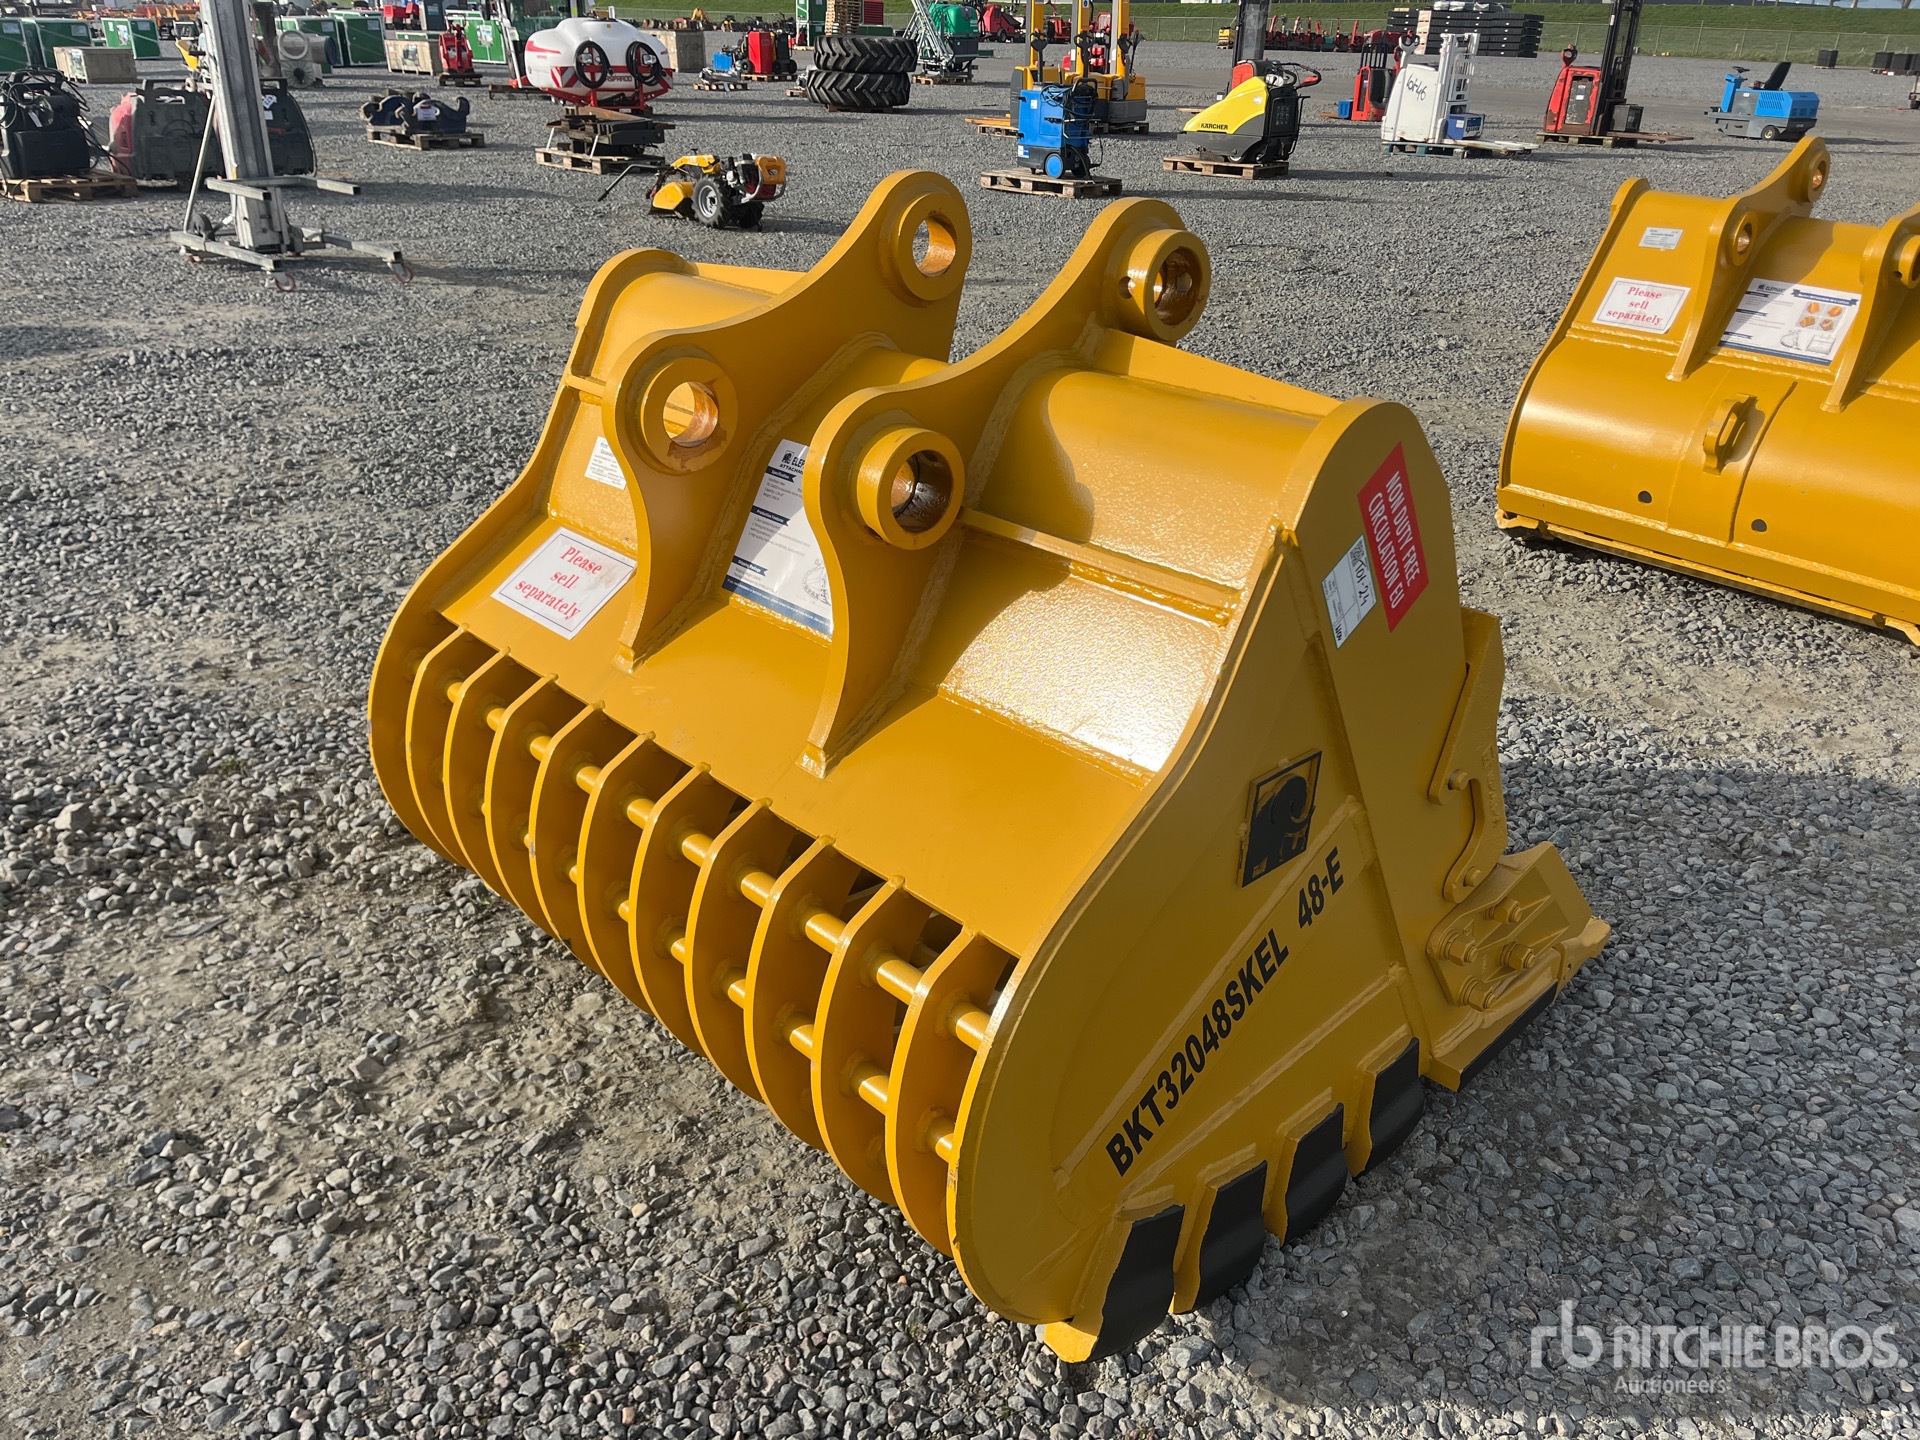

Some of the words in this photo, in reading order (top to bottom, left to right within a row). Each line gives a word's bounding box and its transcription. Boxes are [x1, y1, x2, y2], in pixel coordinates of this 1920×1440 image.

[1627, 286, 1662, 300] Please
[1628, 300, 1649, 310] sell
[1606, 309, 1663, 326] separately
[1386, 470, 1404, 513] NON
[1368, 492, 1400, 589] CIRCULATION
[1389, 582, 1405, 609] EU
[1393, 508, 1413, 551] DUTY
[552, 568, 579, 590] sell
[560, 547, 603, 575] Please
[1402, 545, 1421, 587] FREE
[515, 578, 582, 620] separately
[1105, 928, 1289, 1177] BKT32048SKEL
[1298, 846, 1345, 930] 48-E
